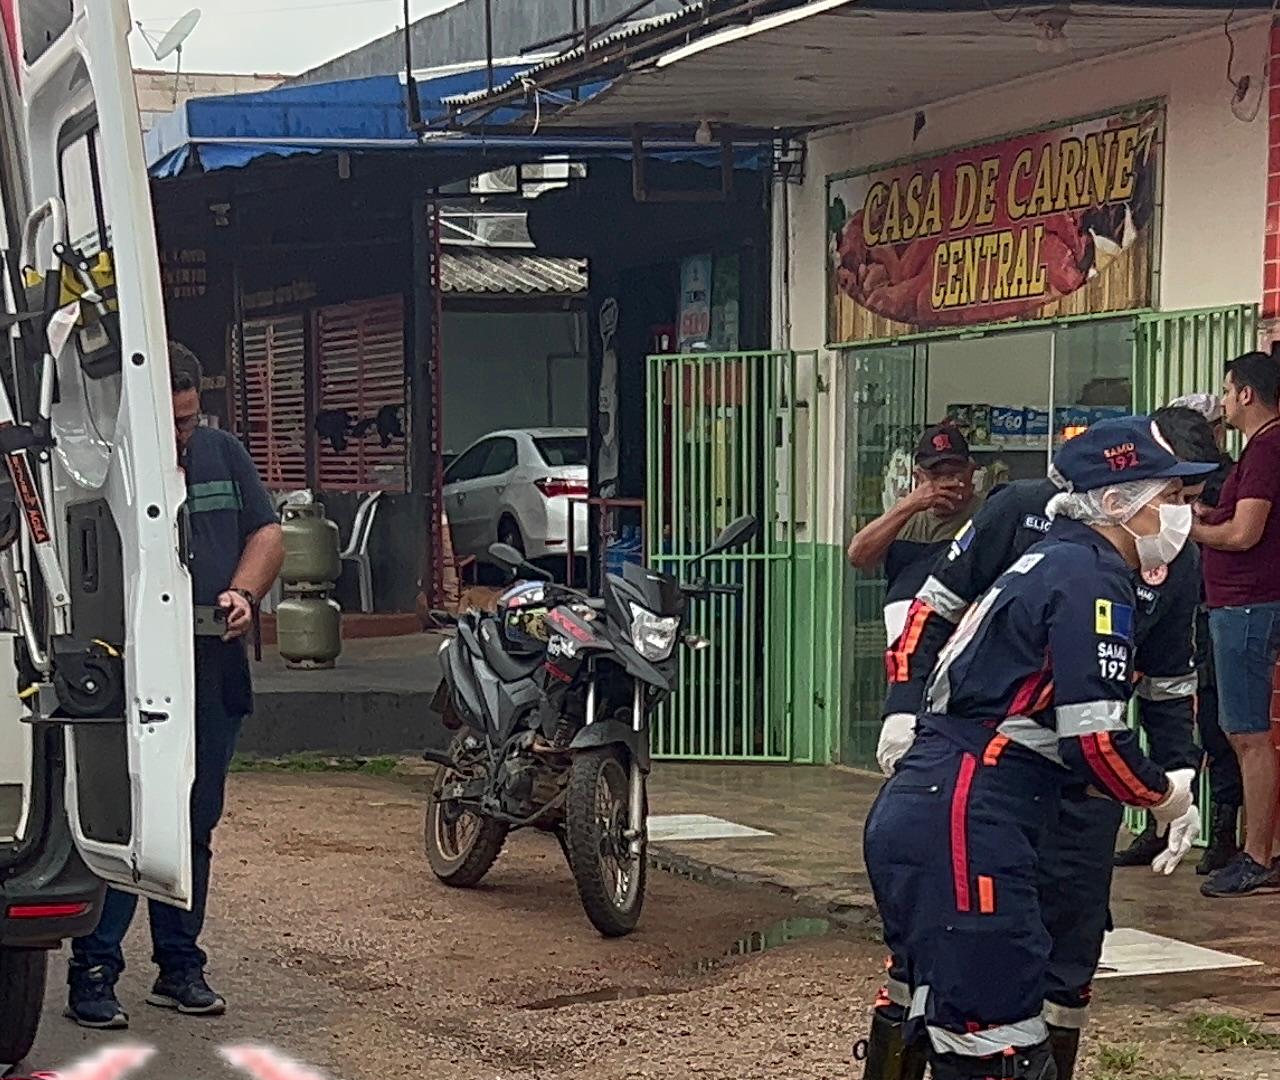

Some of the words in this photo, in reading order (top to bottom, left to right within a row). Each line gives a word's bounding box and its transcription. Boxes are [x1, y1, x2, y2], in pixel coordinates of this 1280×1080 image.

[863, 172, 942, 247] CASA
[951, 158, 1000, 232] DE
[1007, 125, 1139, 221] CARNE
[931, 225, 1048, 310] CENTRAL
[1097, 641, 1128, 661] SAMU
[1098, 659, 1127, 681] 192
